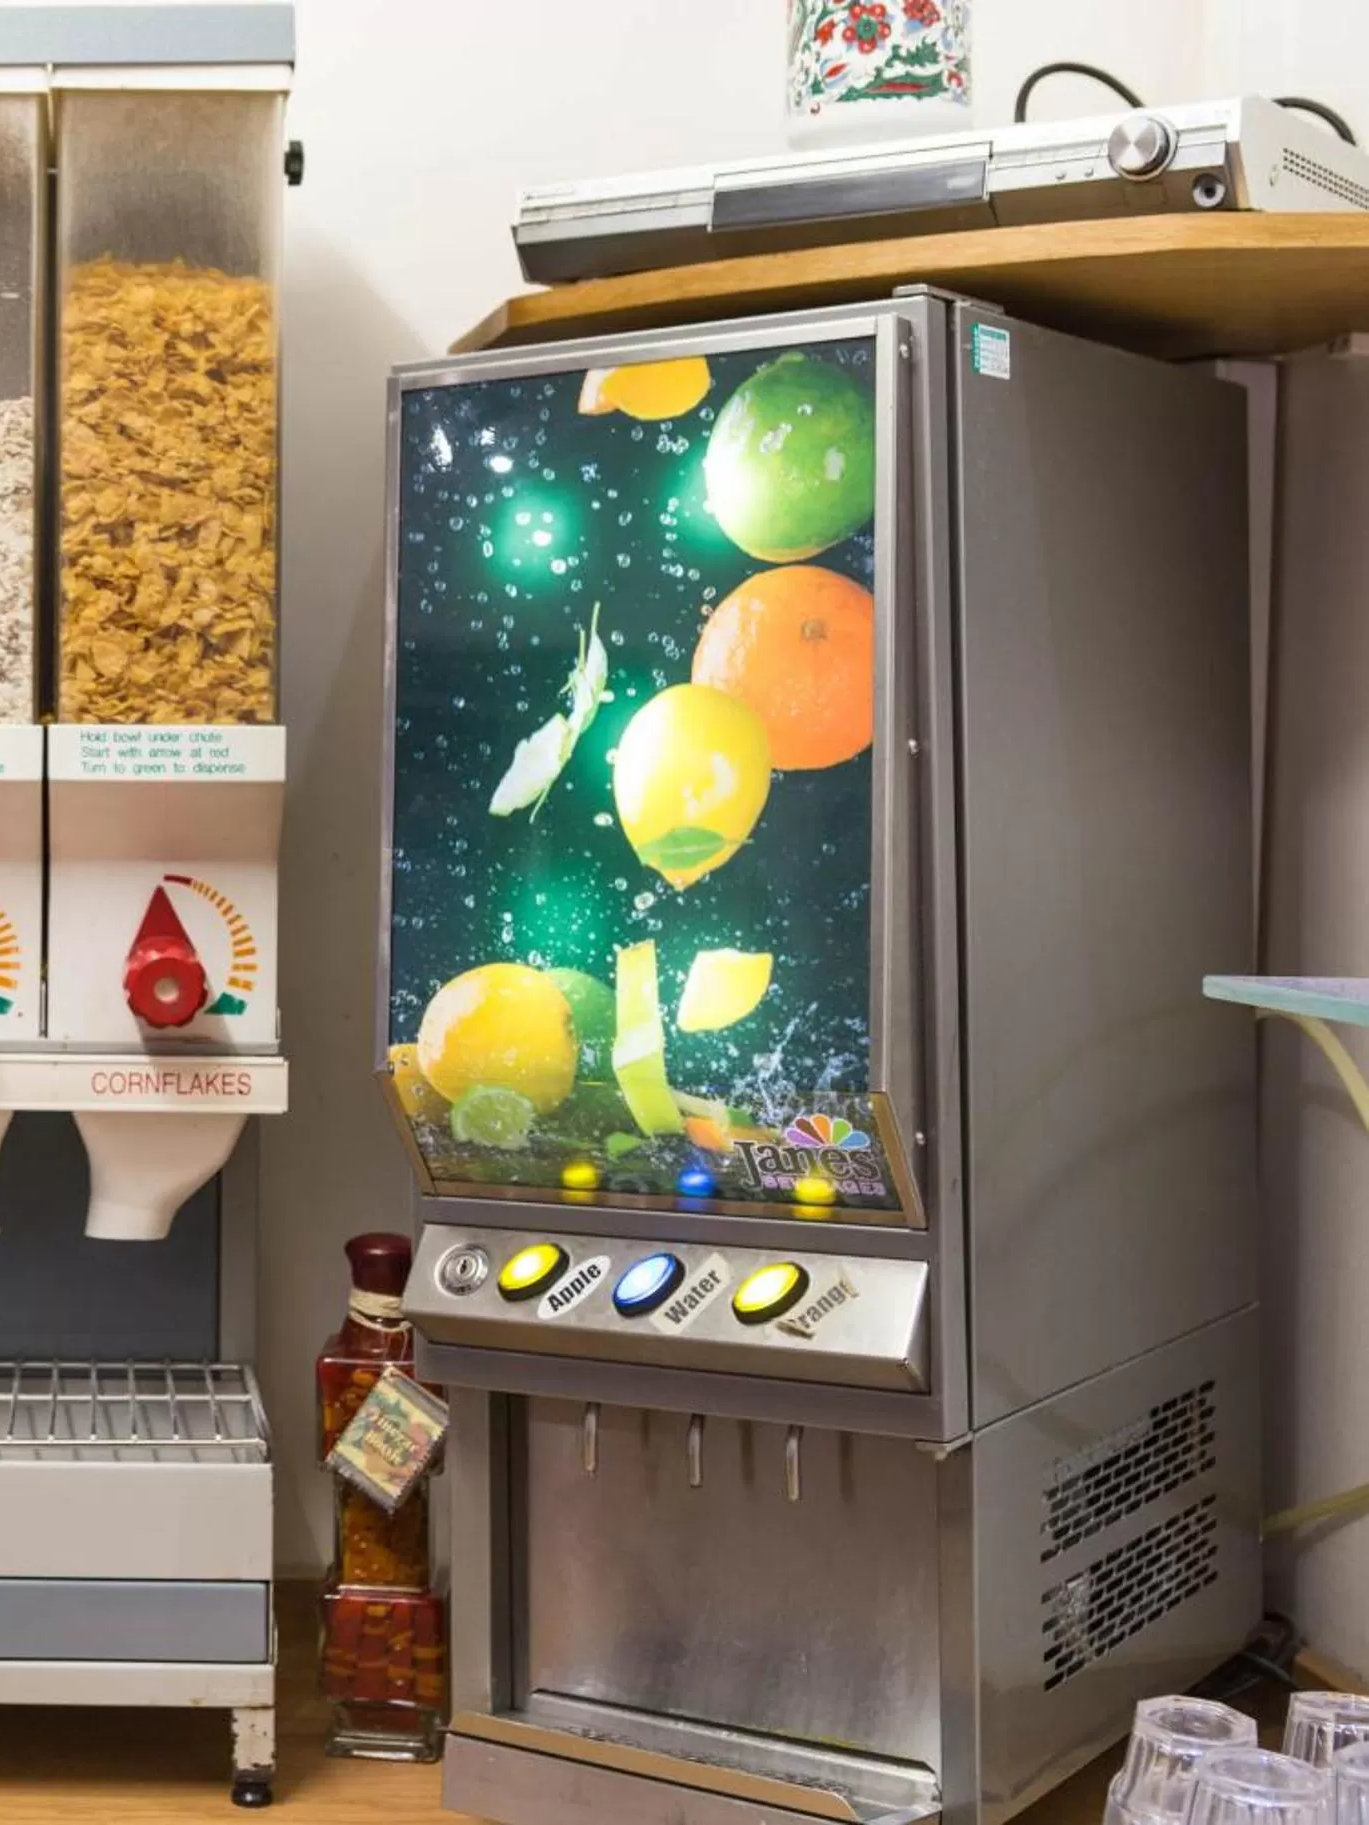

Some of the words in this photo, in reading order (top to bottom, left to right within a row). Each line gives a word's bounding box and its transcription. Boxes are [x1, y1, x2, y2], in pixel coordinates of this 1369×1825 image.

[113, 732, 141, 742] bowl
[148, 732, 180, 742] under
[82, 747, 110, 757] Start
[118, 747, 141, 758] with
[149, 748, 181, 758] arrow
[190, 747, 202, 758] at
[210, 747, 229, 758] red
[82, 762, 106, 773] Turn
[114, 762, 125, 773] to
[133, 764, 166, 775] green
[173, 762, 185, 773] to
[193, 762, 245, 774] dispense
[91, 1071, 252, 1096] CORNFLAKES
[547, 1264, 601, 1312] Apple
[664, 1270, 721, 1324] Water
